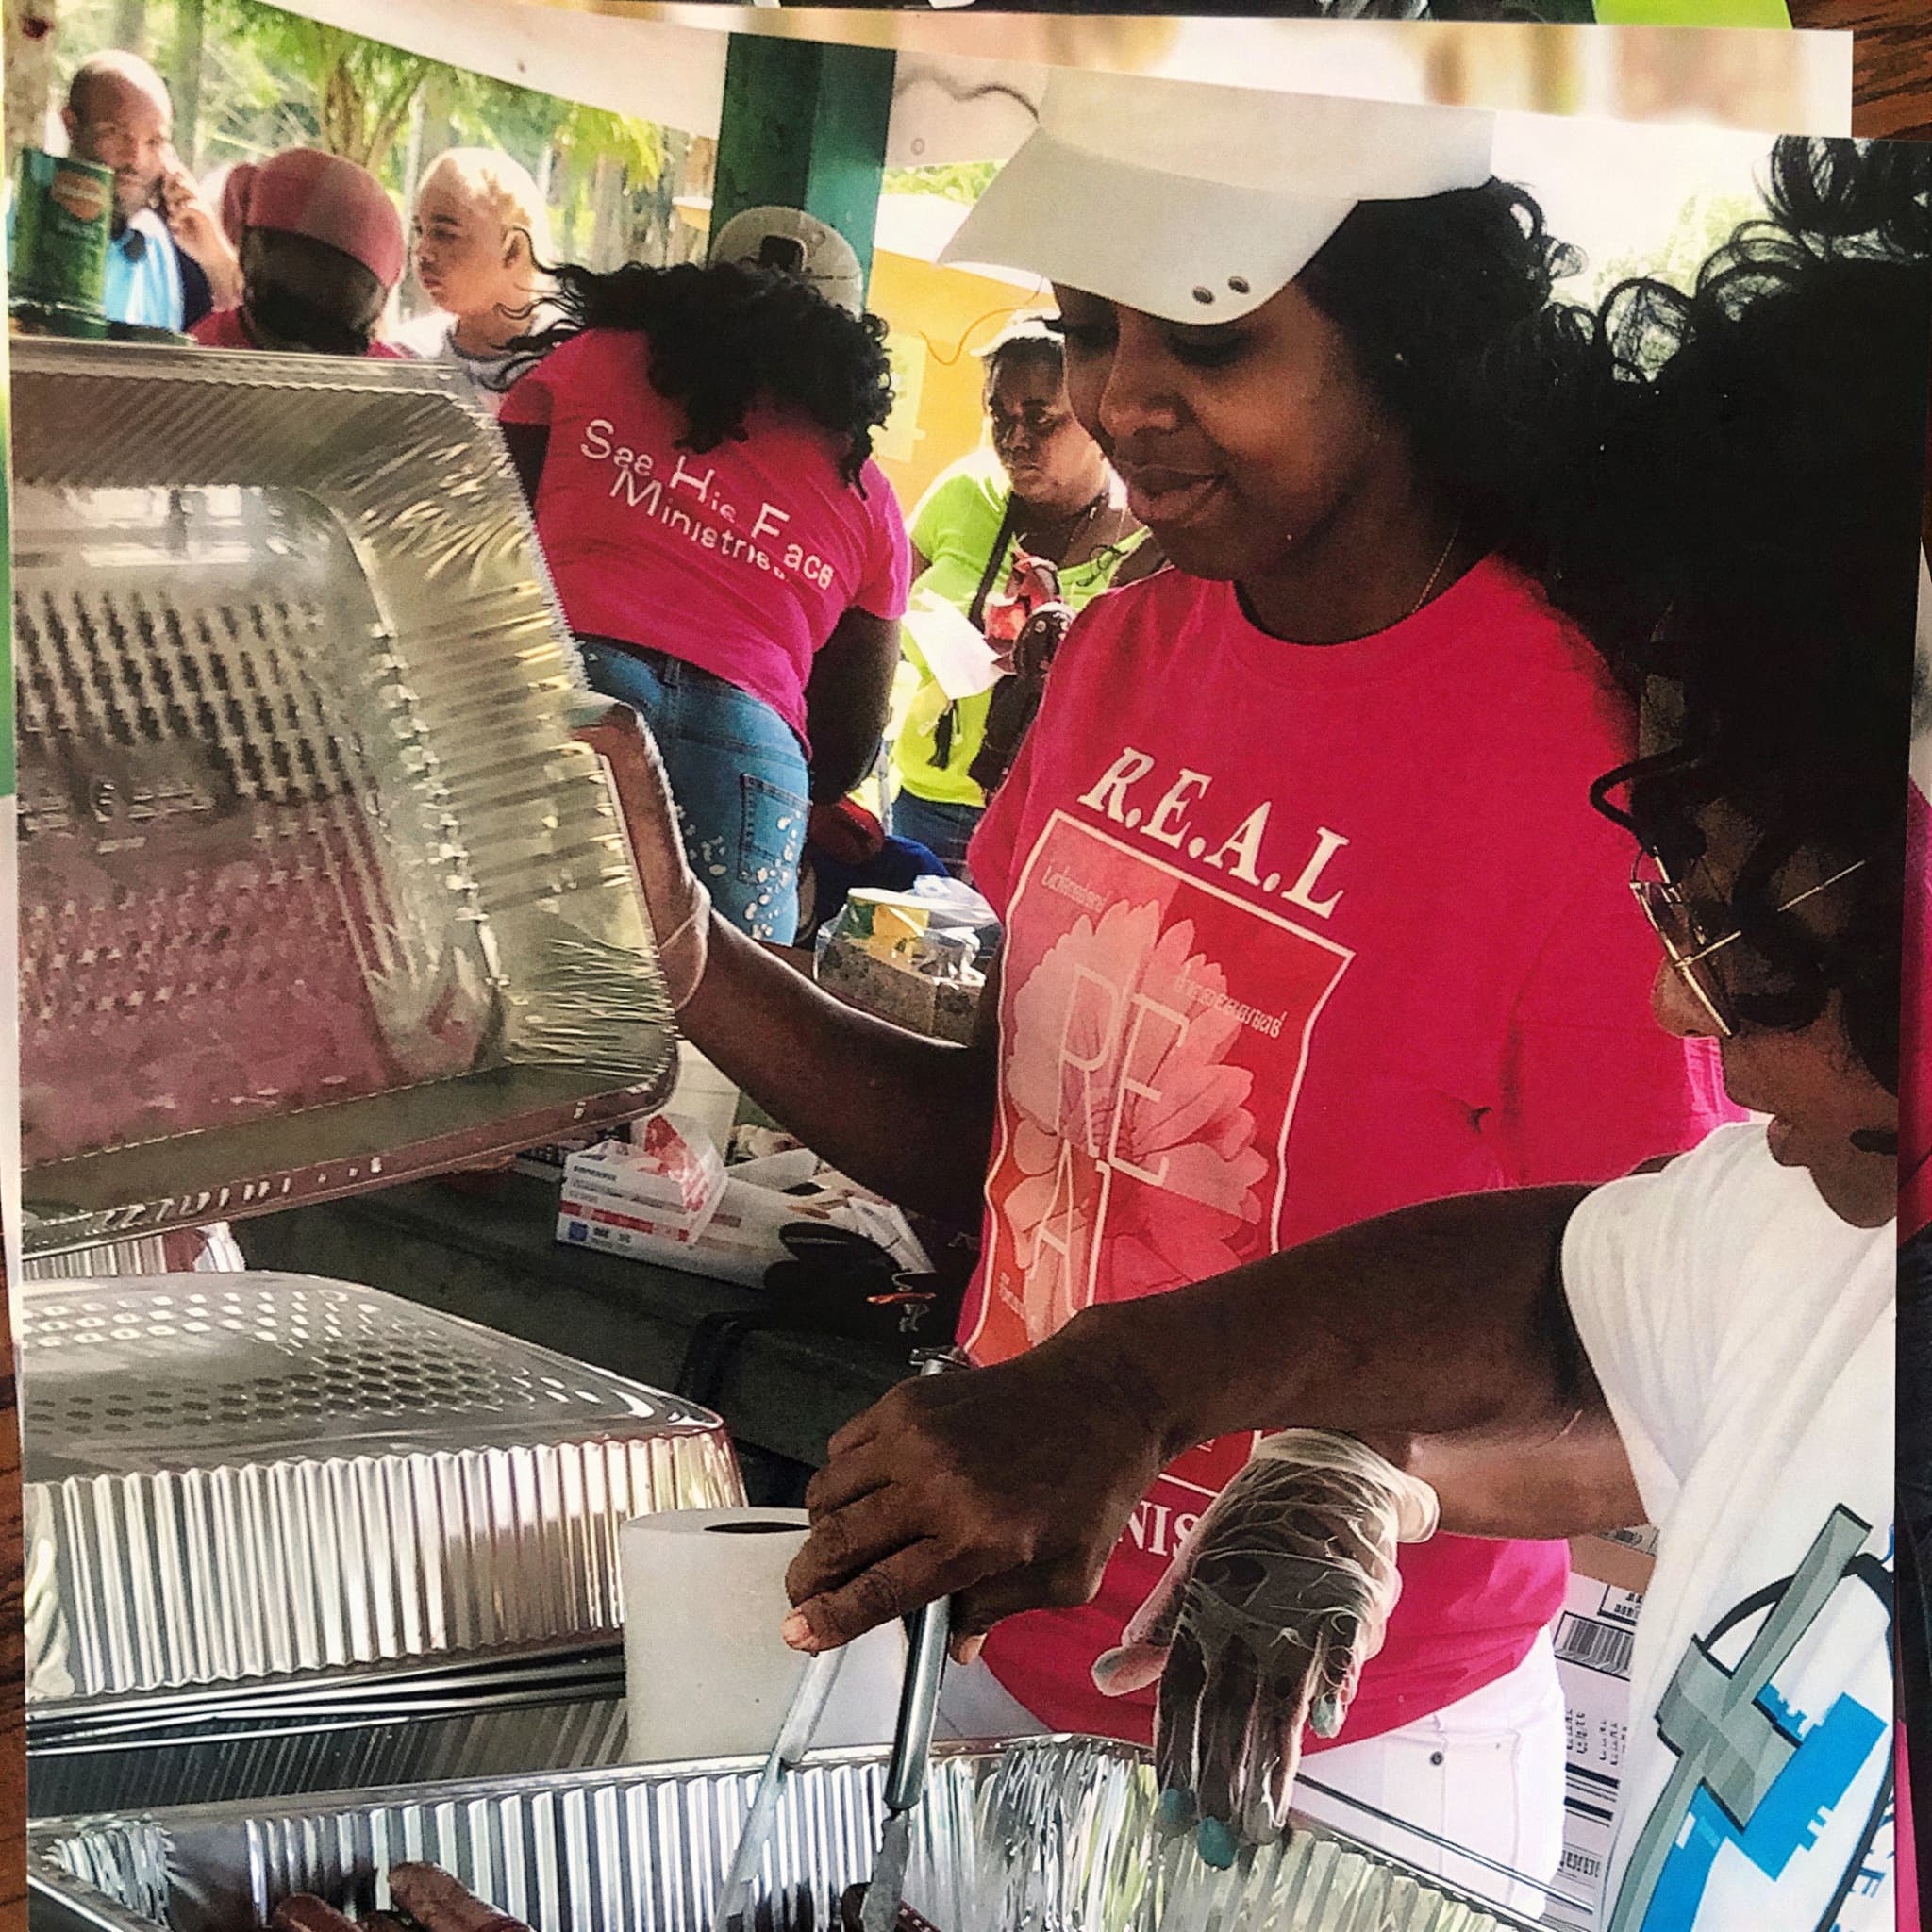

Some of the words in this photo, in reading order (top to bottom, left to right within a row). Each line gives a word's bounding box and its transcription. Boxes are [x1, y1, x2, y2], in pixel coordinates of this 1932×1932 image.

[580, 419, 653, 475] See
[750, 501, 834, 590] Face
[1076, 746, 1350, 919] R.E.A.L
